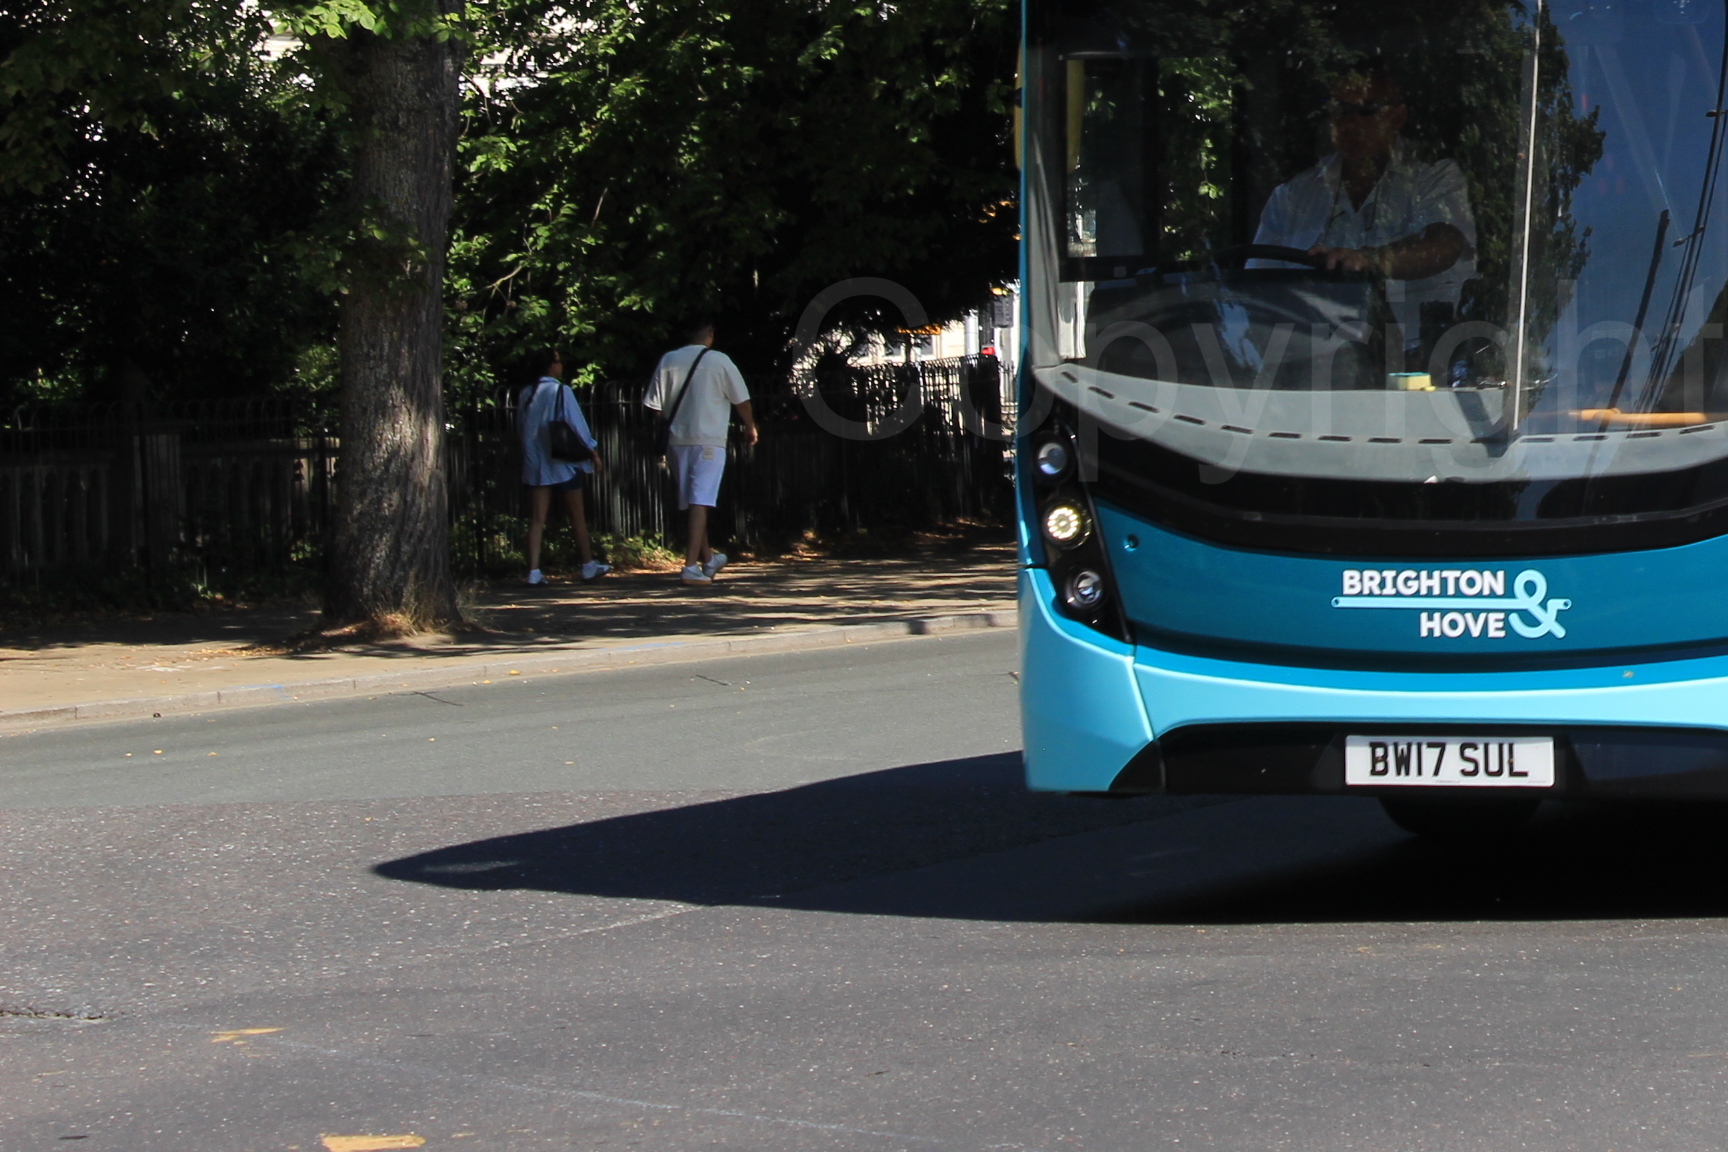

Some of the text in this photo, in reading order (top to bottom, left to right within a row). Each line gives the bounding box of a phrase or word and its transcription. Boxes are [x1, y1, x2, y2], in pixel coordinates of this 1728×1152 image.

[1342, 569, 1505, 596] BRIGHTON
[1419, 611, 1506, 638] HOVE
[1368, 741, 1529, 778] BW17 SUL
